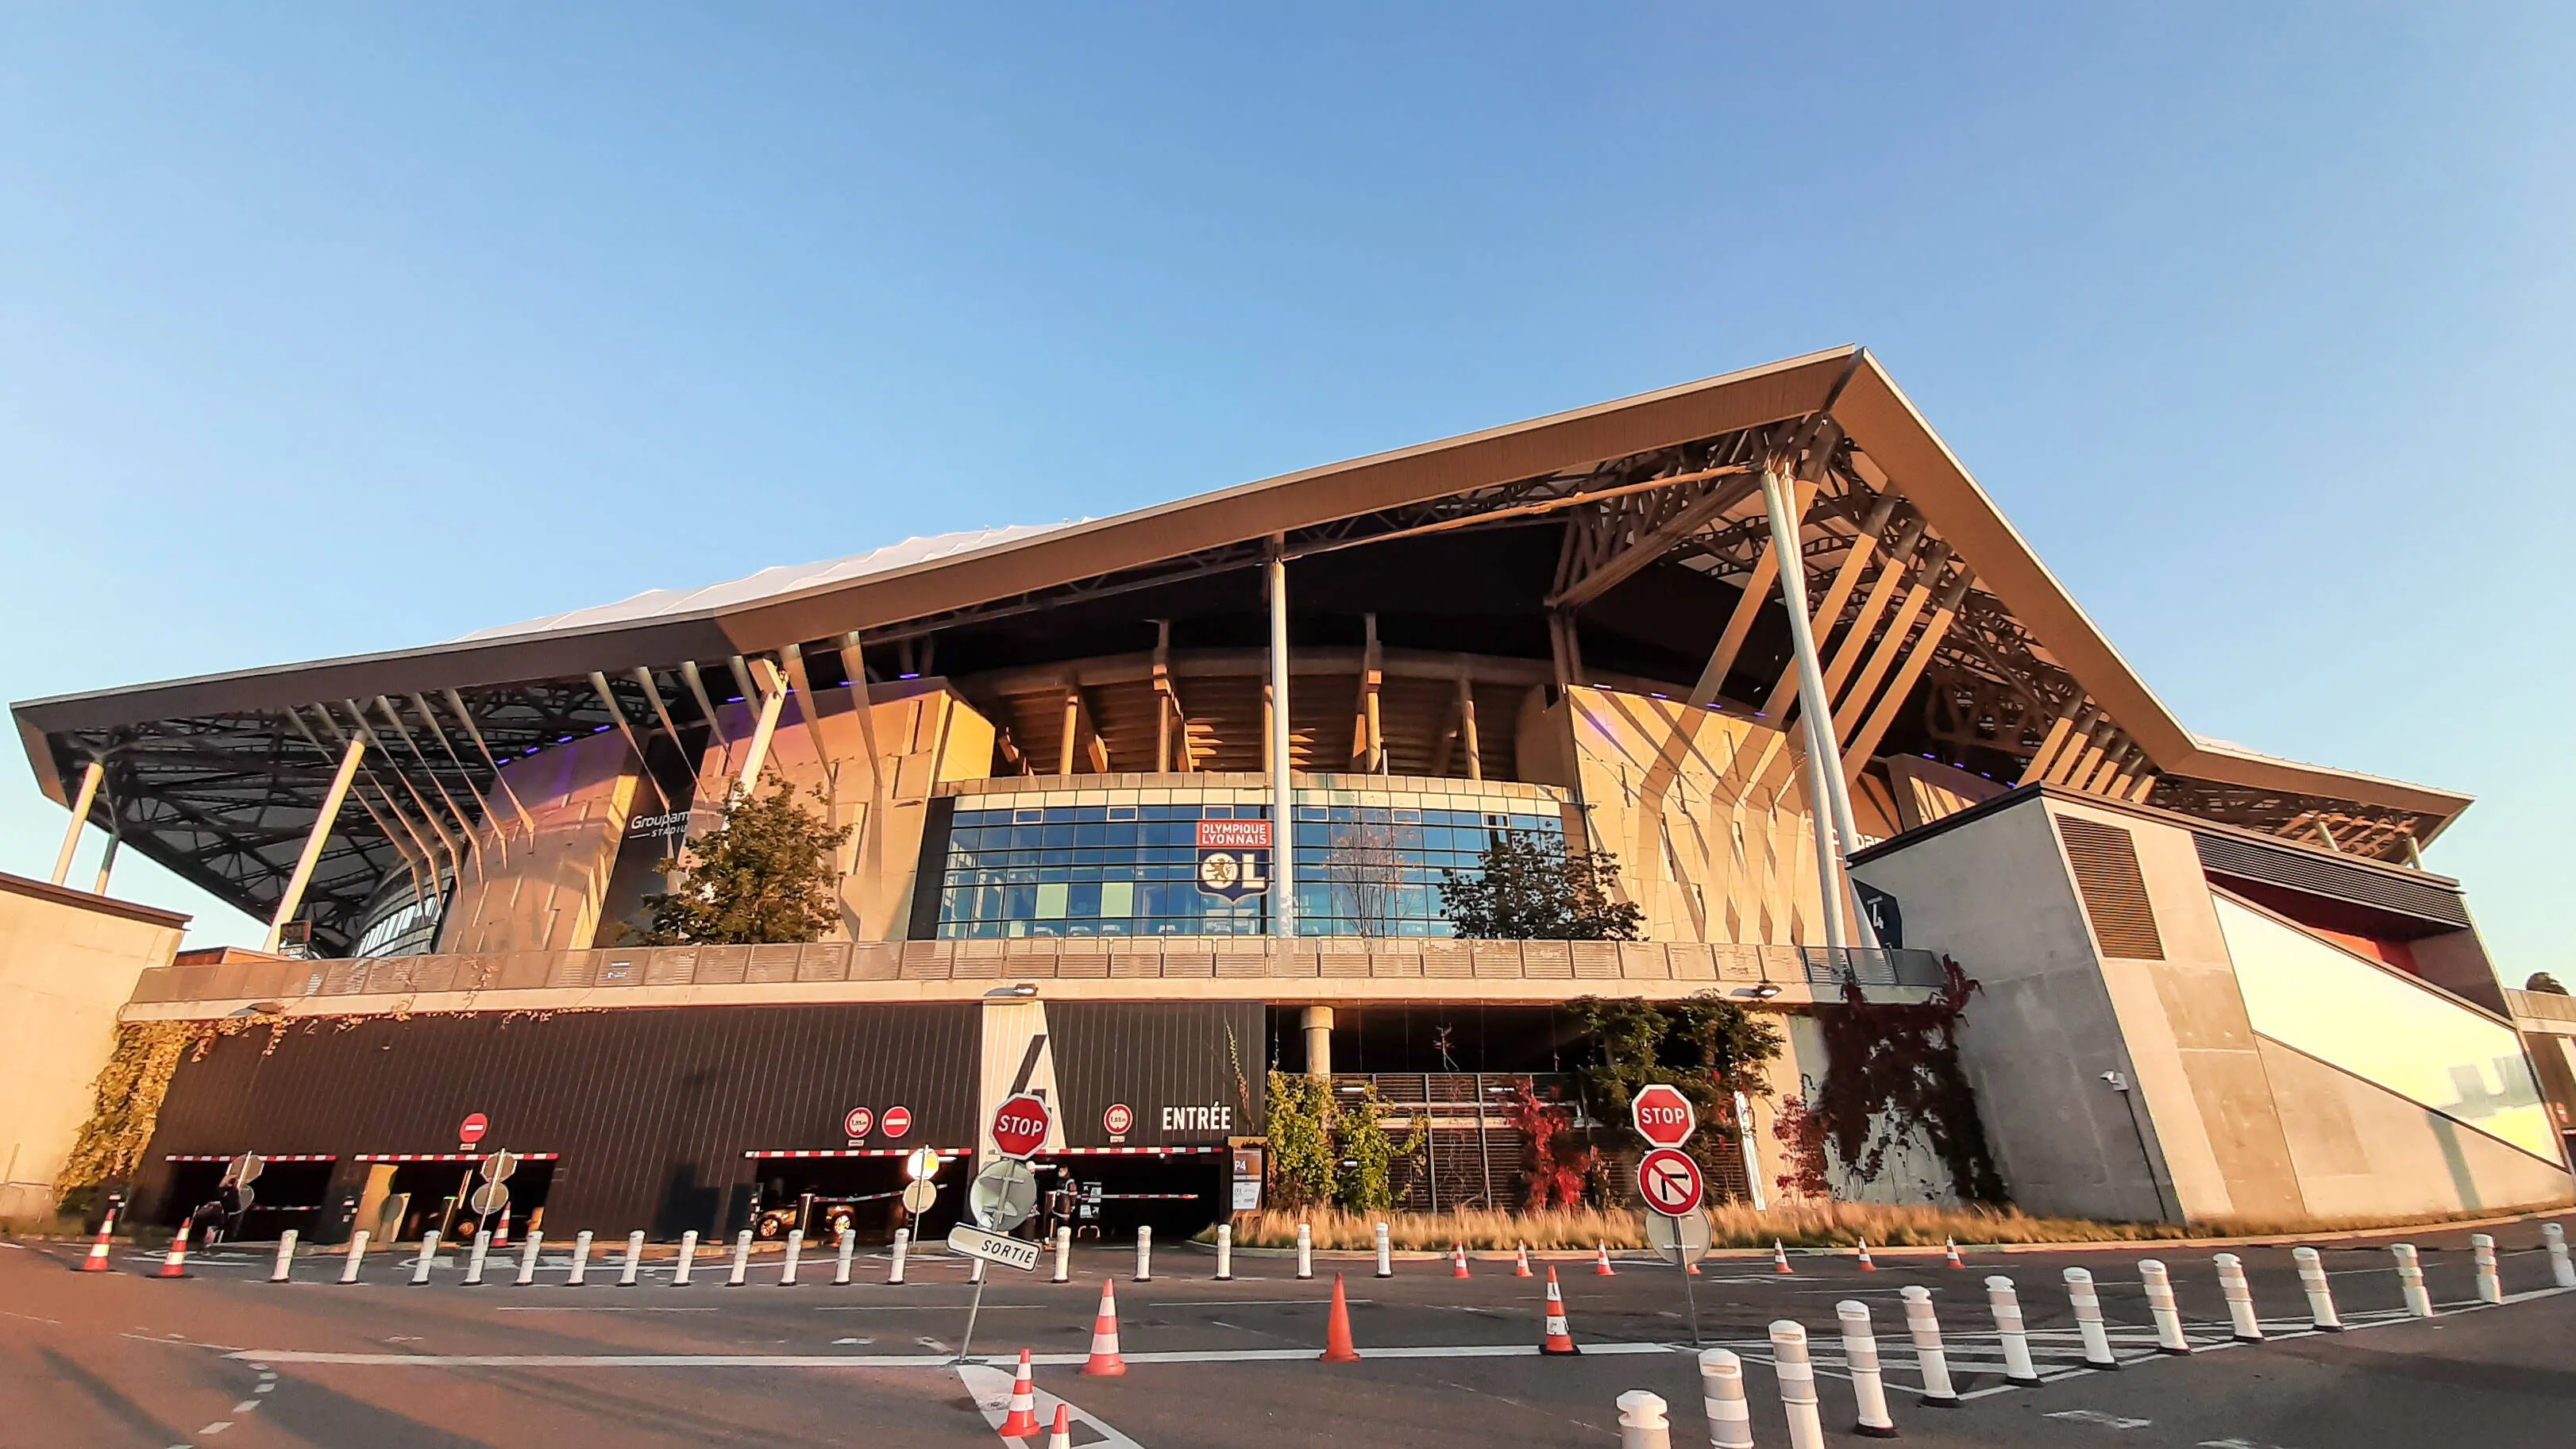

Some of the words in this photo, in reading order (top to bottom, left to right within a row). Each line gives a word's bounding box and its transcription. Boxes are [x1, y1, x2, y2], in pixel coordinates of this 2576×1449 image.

[631, 811, 690, 830] Groupam
[1201, 823, 1266, 834] OLYMPIQUE
[651, 825, 688, 838] STADIU
[1201, 834, 1267, 845] LYONNAIS
[1872, 904, 1884, 930] 4
[1162, 1100, 1231, 1130] ENTRÉE
[1641, 1107, 1685, 1124] STOP
[997, 1114, 1043, 1137] STOP
[1235, 1160, 1247, 1171] P4
[981, 1239, 1035, 1264] SORTIE
